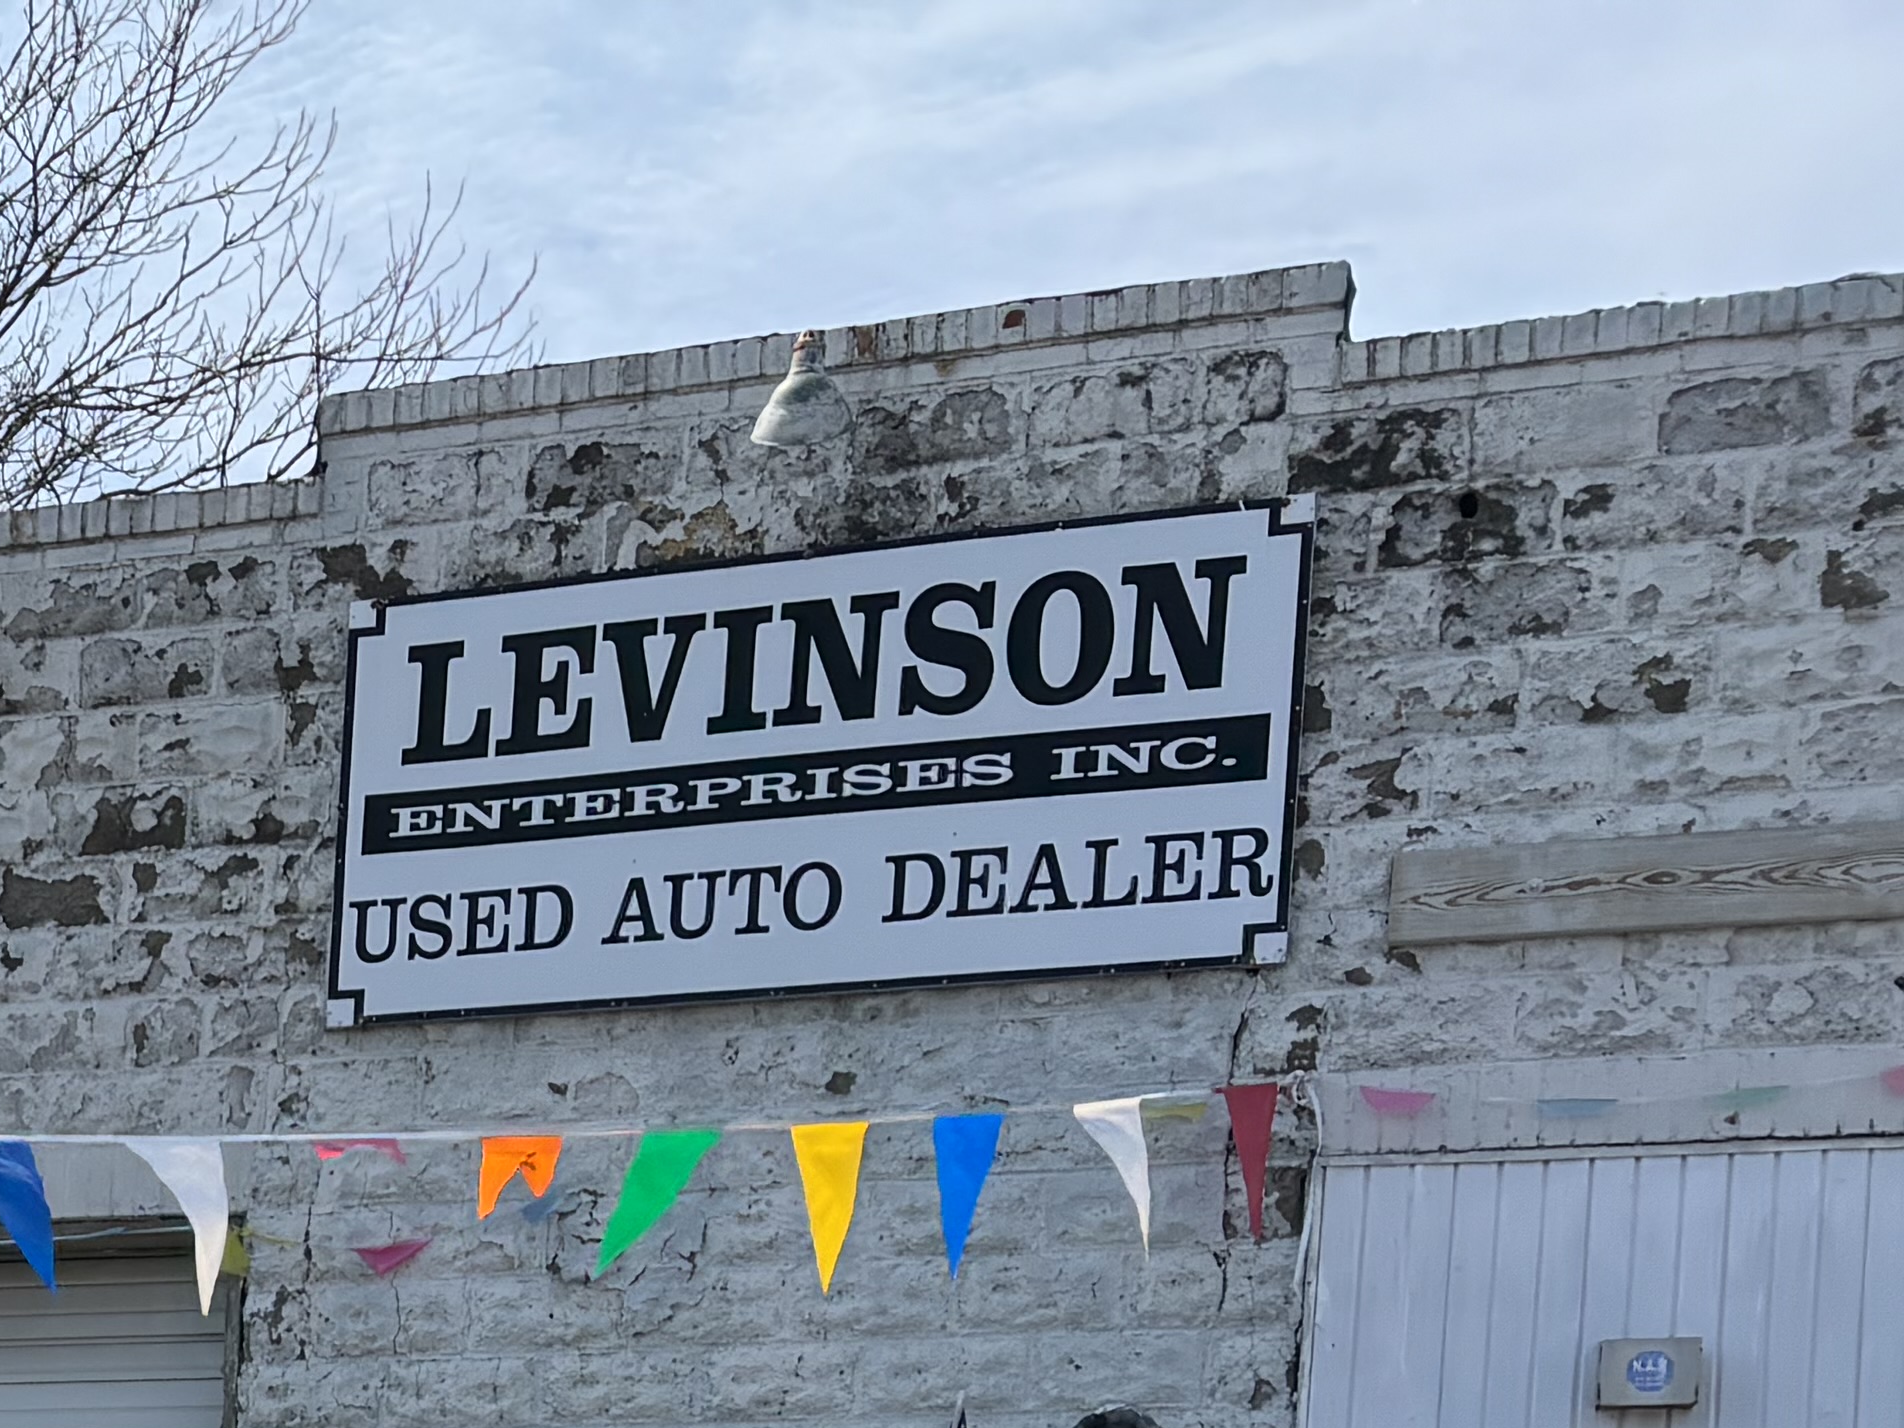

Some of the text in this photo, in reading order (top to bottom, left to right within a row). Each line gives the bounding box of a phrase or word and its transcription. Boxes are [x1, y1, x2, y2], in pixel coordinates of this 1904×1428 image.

[400, 555, 1248, 766] LEVINSON
[388, 734, 1239, 838] ENTERPRISES INC.
[349, 826, 1274, 963] USED AUTO DEALER
